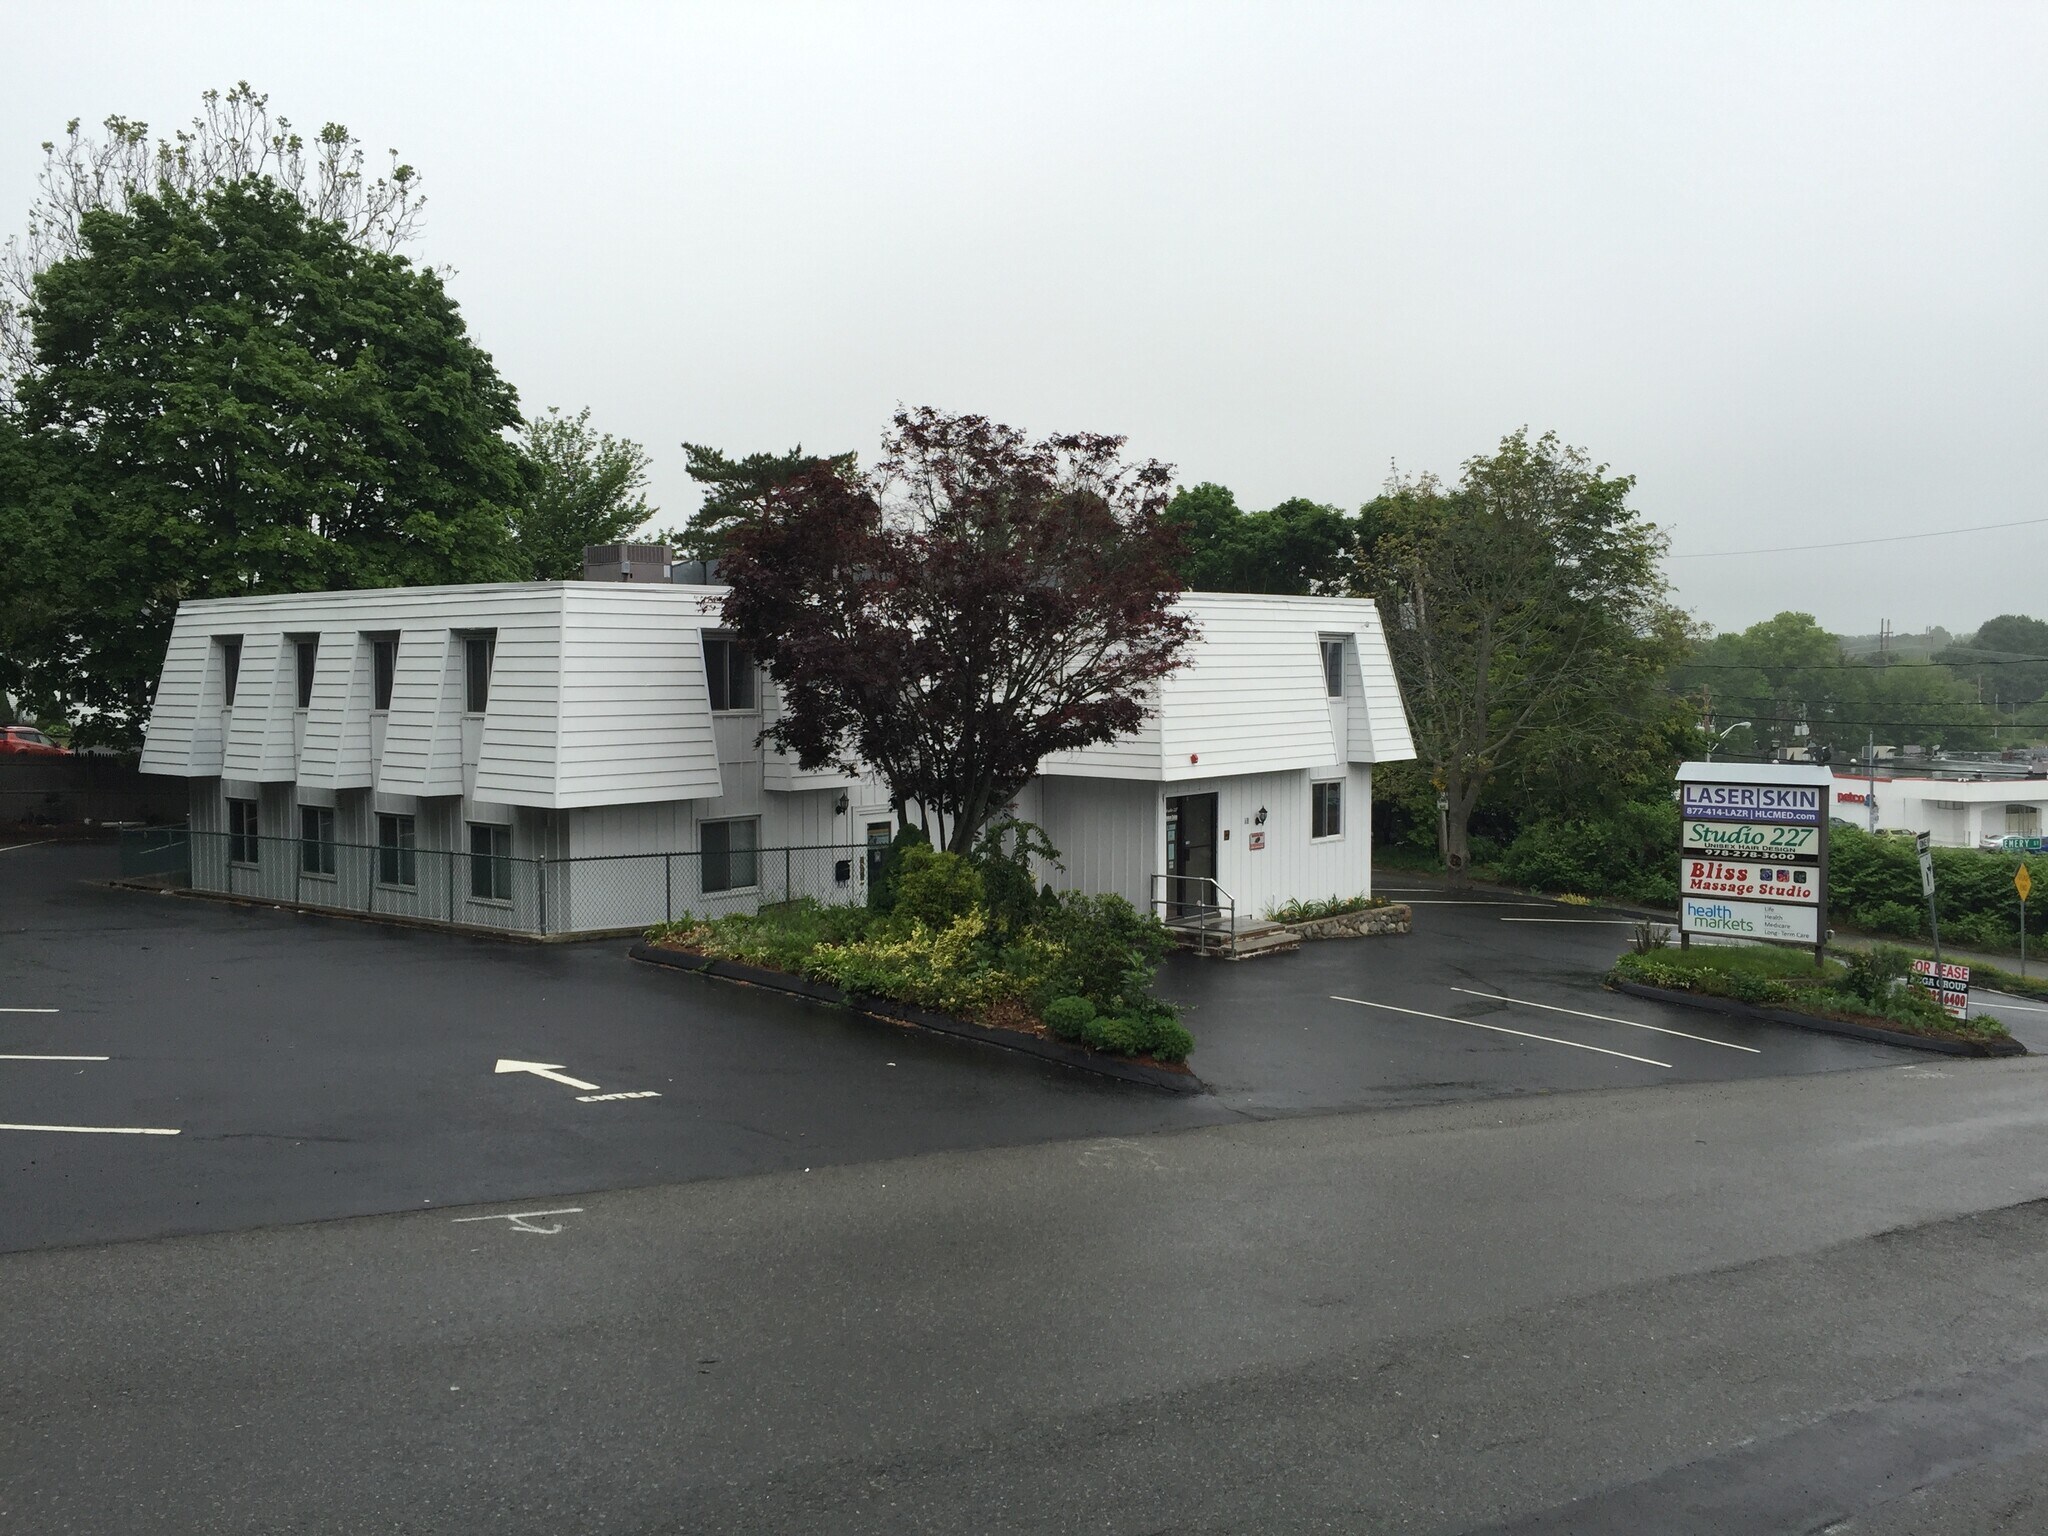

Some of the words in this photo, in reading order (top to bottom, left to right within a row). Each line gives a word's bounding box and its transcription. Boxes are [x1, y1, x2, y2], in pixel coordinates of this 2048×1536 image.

[1837, 792, 1865, 803] petco
[1686, 807, 1749, 818] 877-414-LAZR
[1755, 810, 1816, 821] HLCMED.com
[1688, 823, 1765, 845] Studio
[1769, 827, 1814, 847] 227
[1762, 845, 1796, 853] DESIGN
[2004, 839, 2030, 848] EMERY
[1704, 849, 1796, 861] 978-278-3600
[1690, 862, 1748, 881] Bliss
[1690, 878, 1754, 896] Massage
[1758, 884, 1811, 898] Studio
[1688, 902, 1732, 919] health
[1694, 916, 1754, 932] markets
[1765, 921, 1791, 929] Medicare
